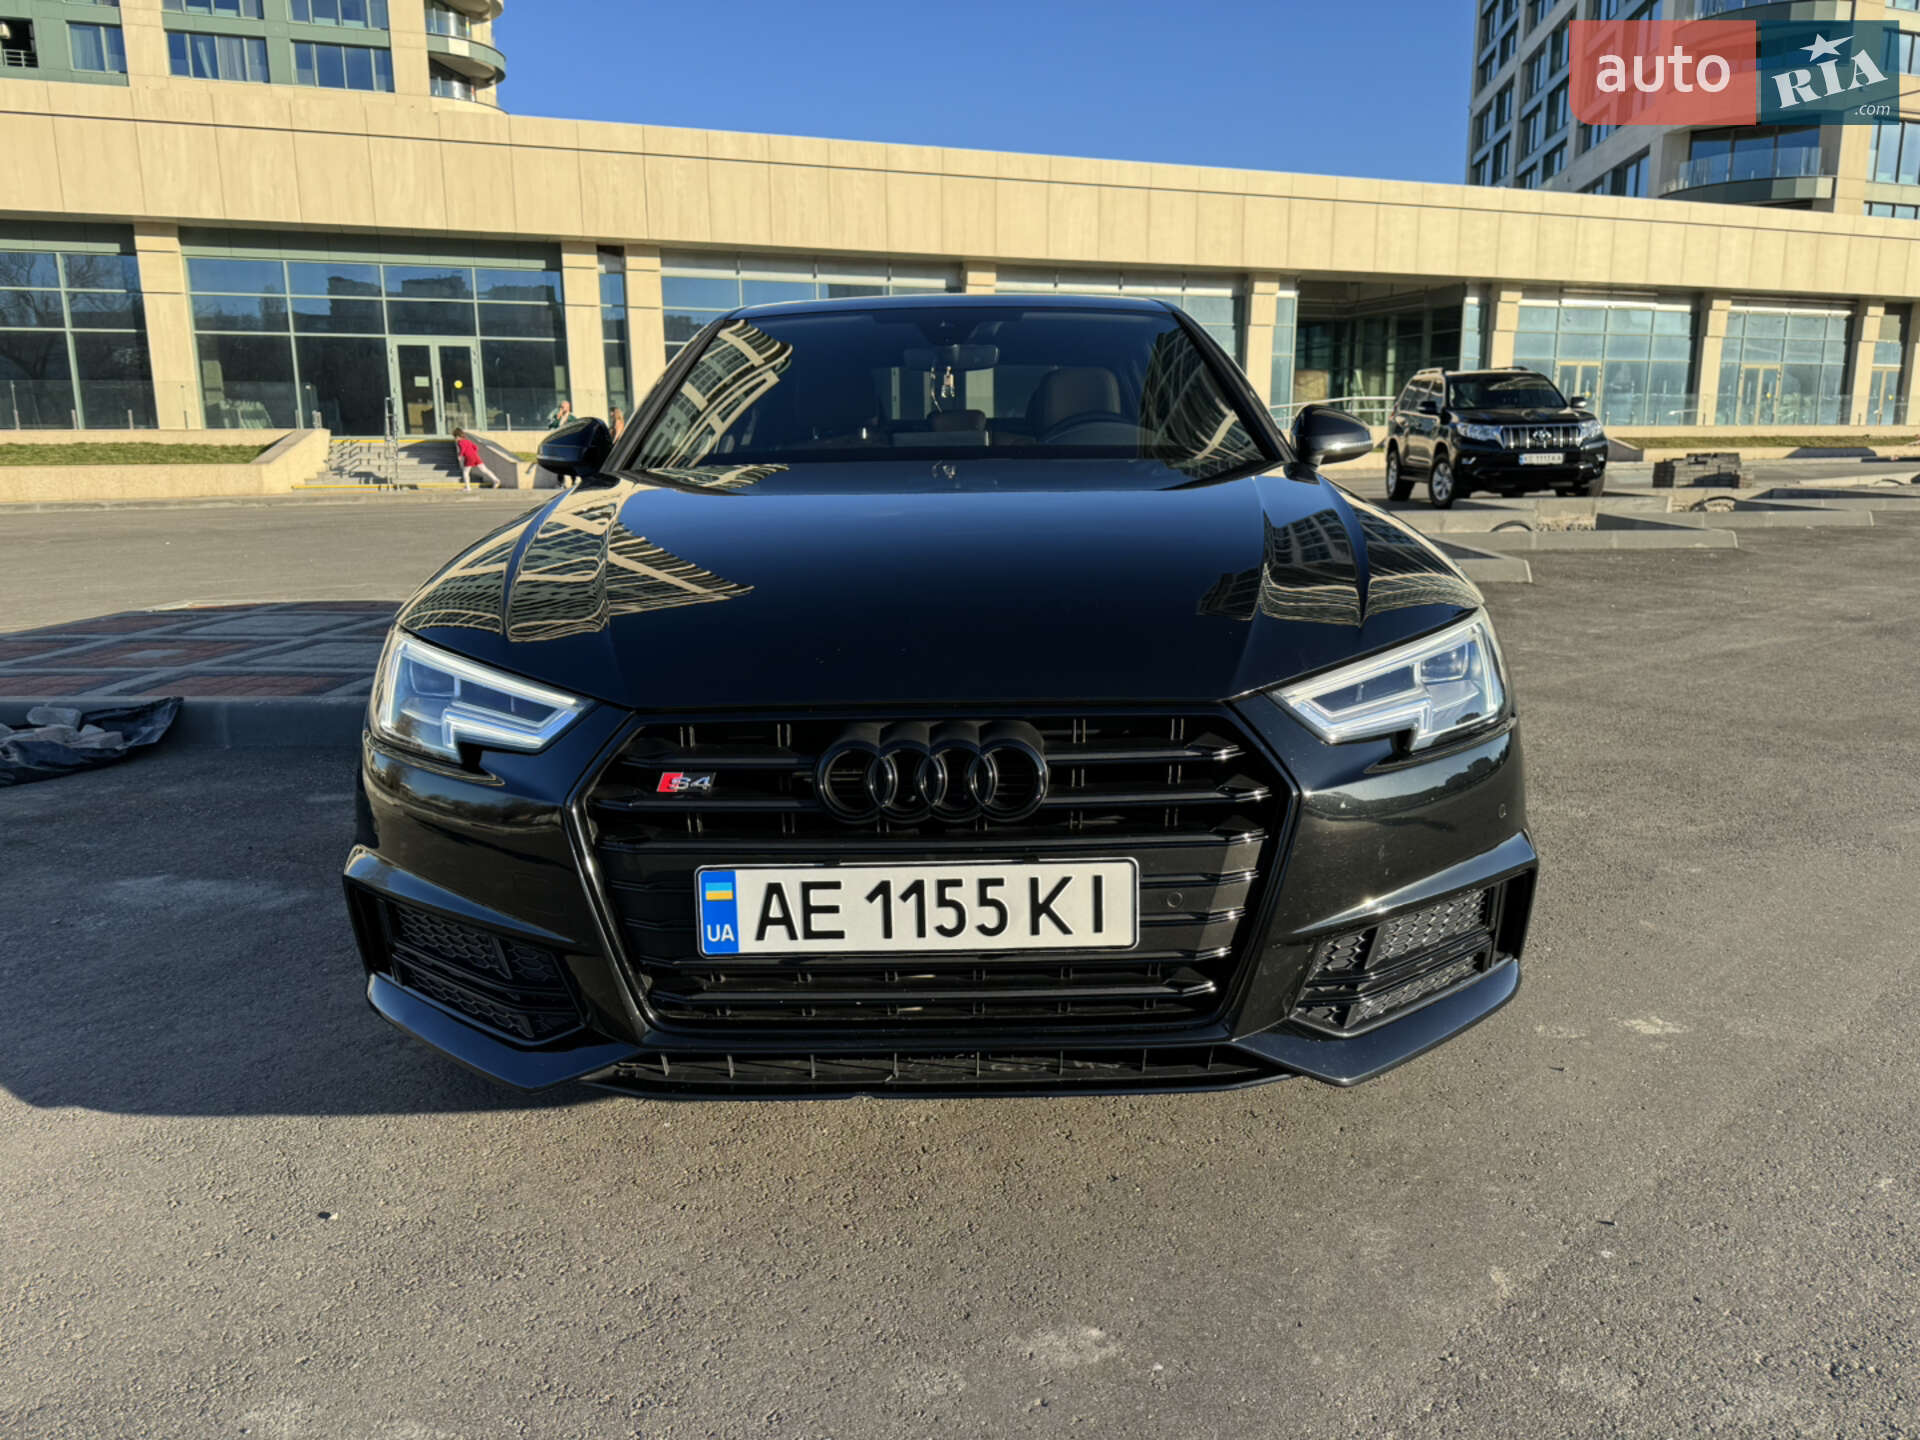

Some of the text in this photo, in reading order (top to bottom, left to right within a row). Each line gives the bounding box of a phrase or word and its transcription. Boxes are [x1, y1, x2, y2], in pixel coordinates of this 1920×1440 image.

[668, 775, 712, 790] S4
[755, 874, 1104, 941] AE 1155 KI
[706, 923, 735, 943] UA
